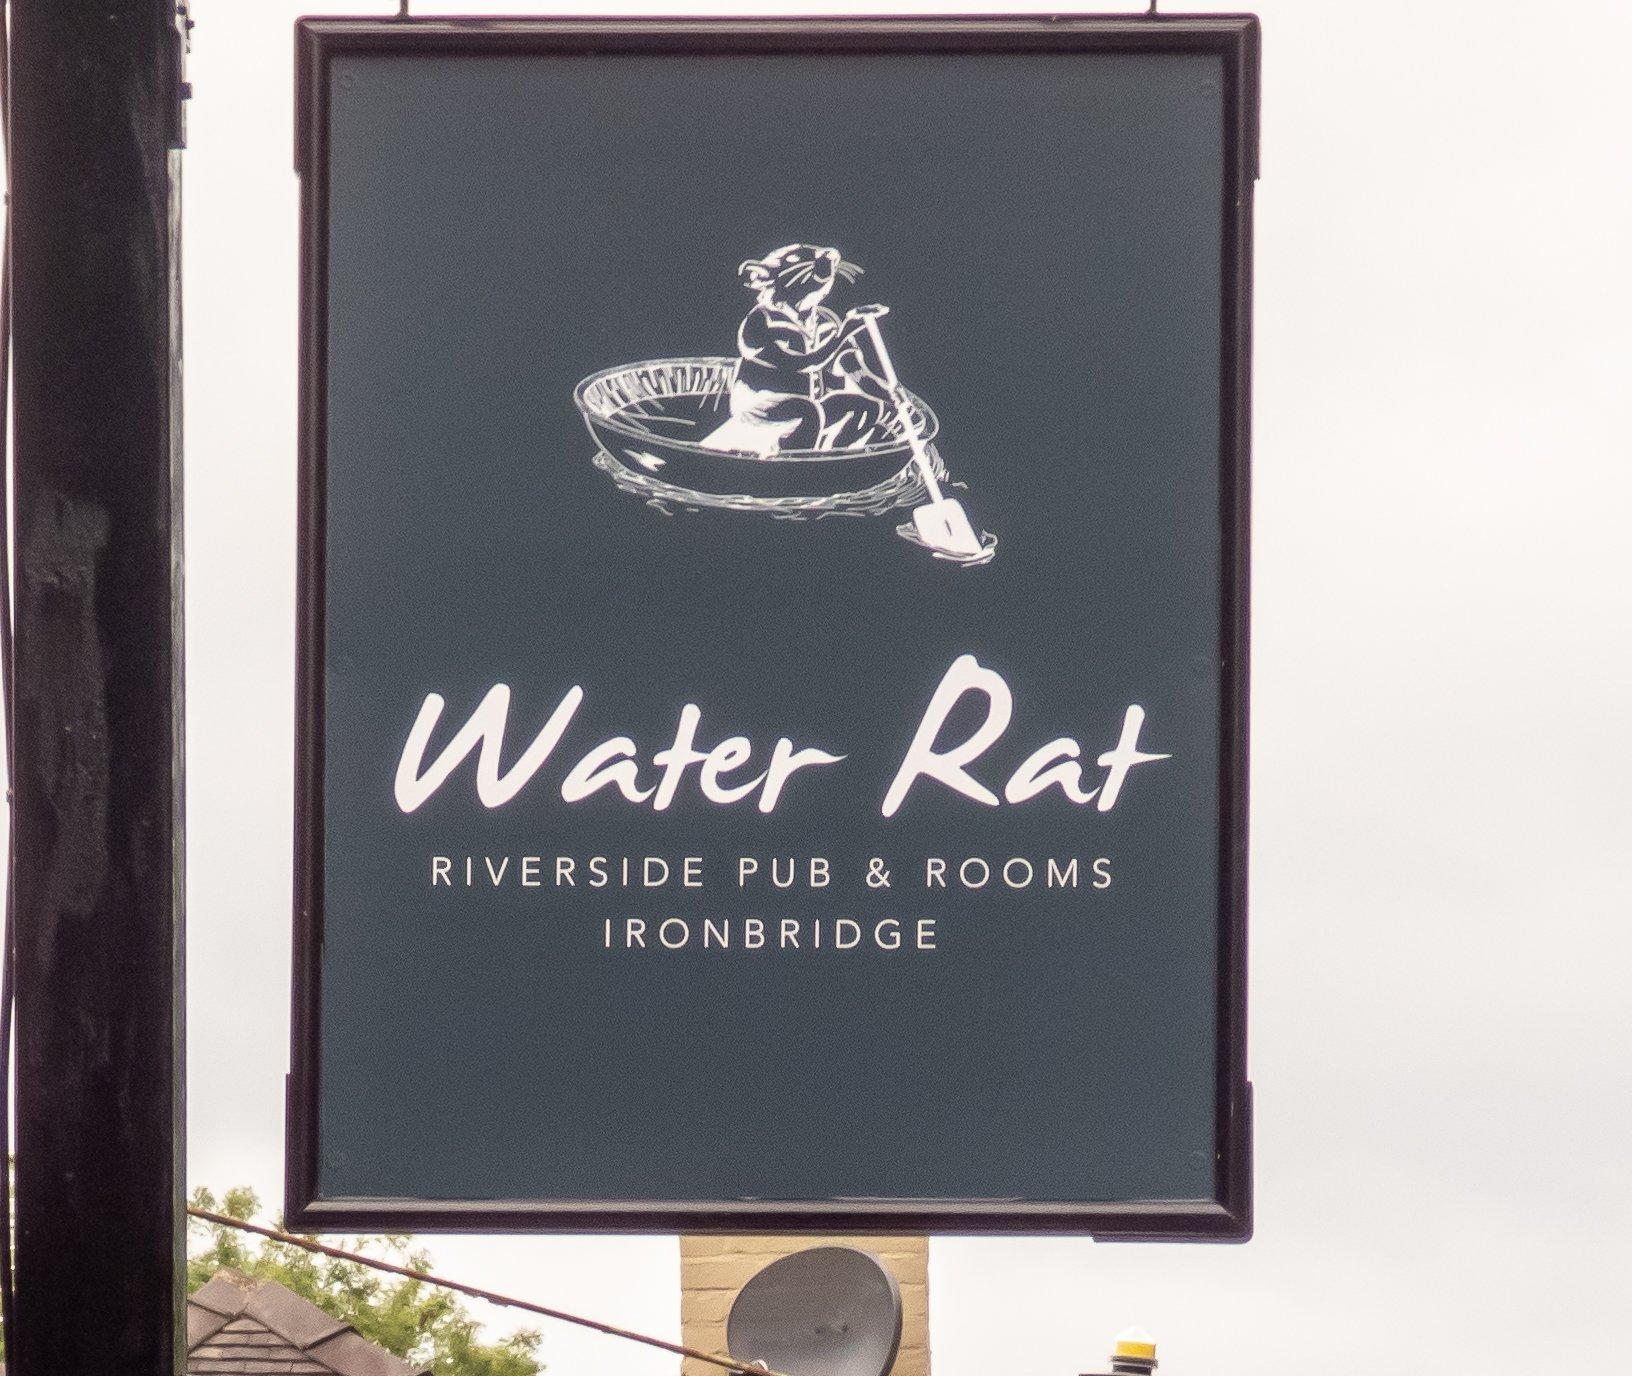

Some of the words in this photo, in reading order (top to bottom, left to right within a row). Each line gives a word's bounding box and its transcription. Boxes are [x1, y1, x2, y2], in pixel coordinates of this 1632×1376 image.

[393, 682, 848, 814] Water
[881, 654, 1173, 818] Rat
[431, 856, 705, 889] RIVERSIDE
[738, 857, 832, 889] PUB
[864, 857, 893, 889] &
[925, 857, 1113, 889] ROOMS
[604, 917, 938, 950] IRONBRIDGE
